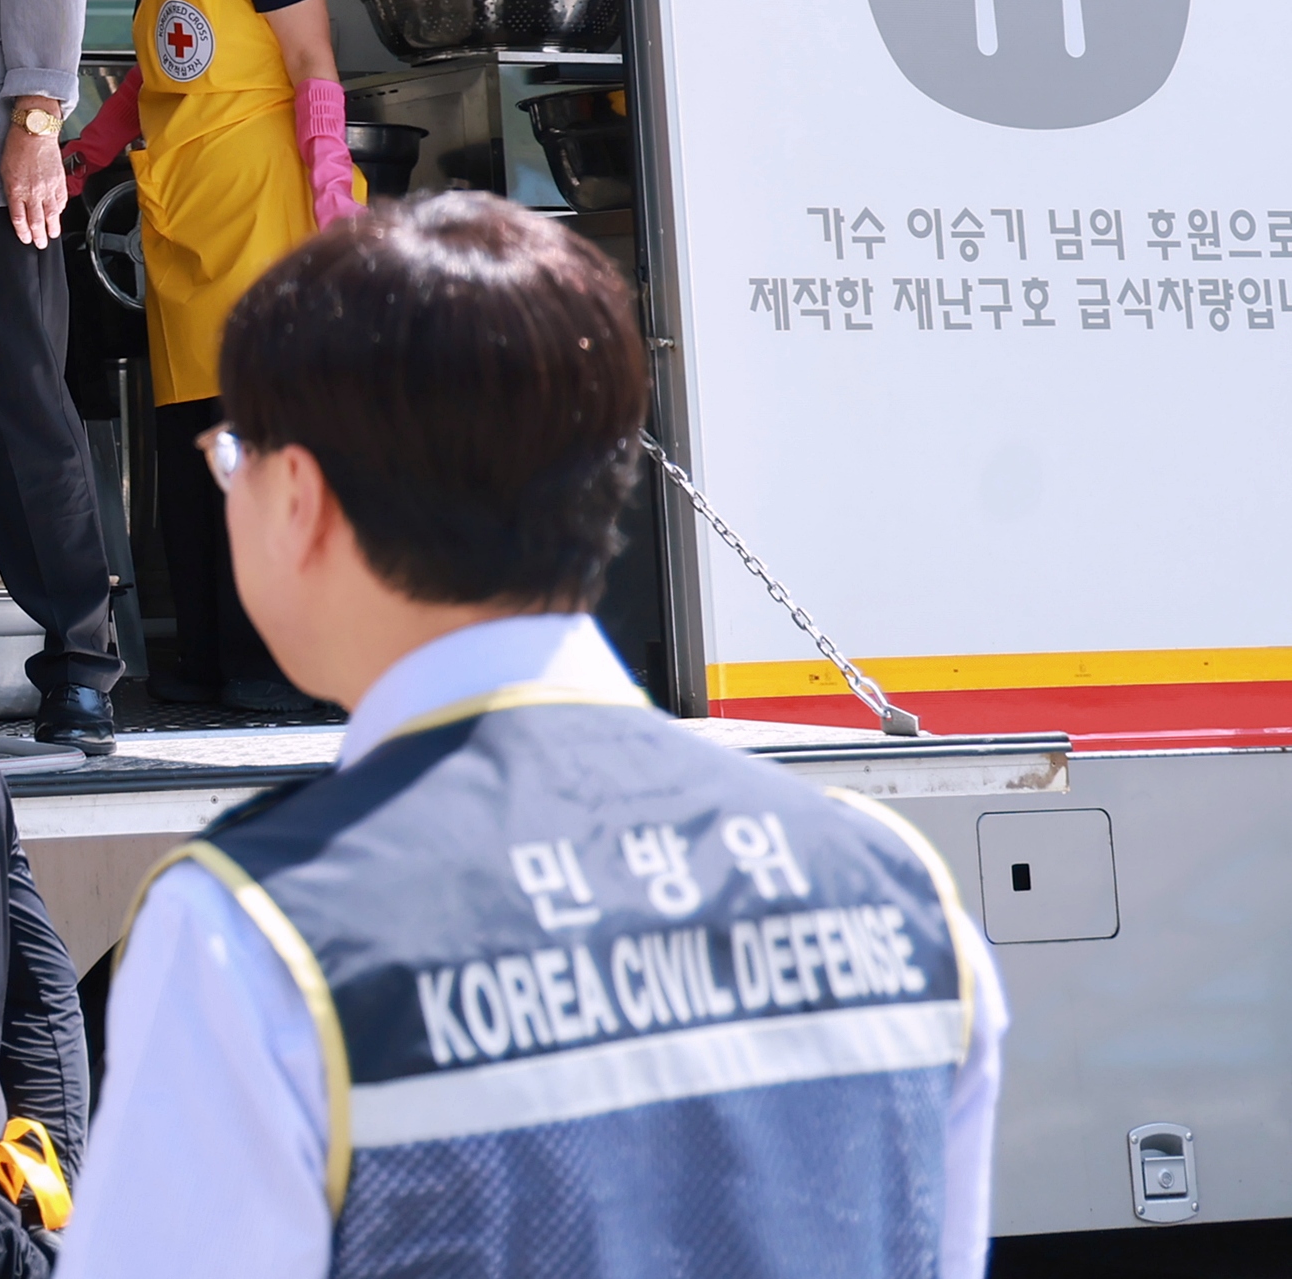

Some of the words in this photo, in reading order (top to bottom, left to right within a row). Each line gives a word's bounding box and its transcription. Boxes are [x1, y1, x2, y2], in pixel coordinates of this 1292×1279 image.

[188, 12, 209, 42] CROSS
[806, 205, 887, 261] 가수
[907, 206, 1028, 263] 이승기
[1047, 208, 1126, 262] 님의
[747, 277, 875, 331] 제작한
[892, 277, 1057, 331] 재난구호
[418, 945, 619, 1066] KOREA
[611, 926, 738, 1030] CIVIL
[730, 905, 928, 1011] DEFENSE
